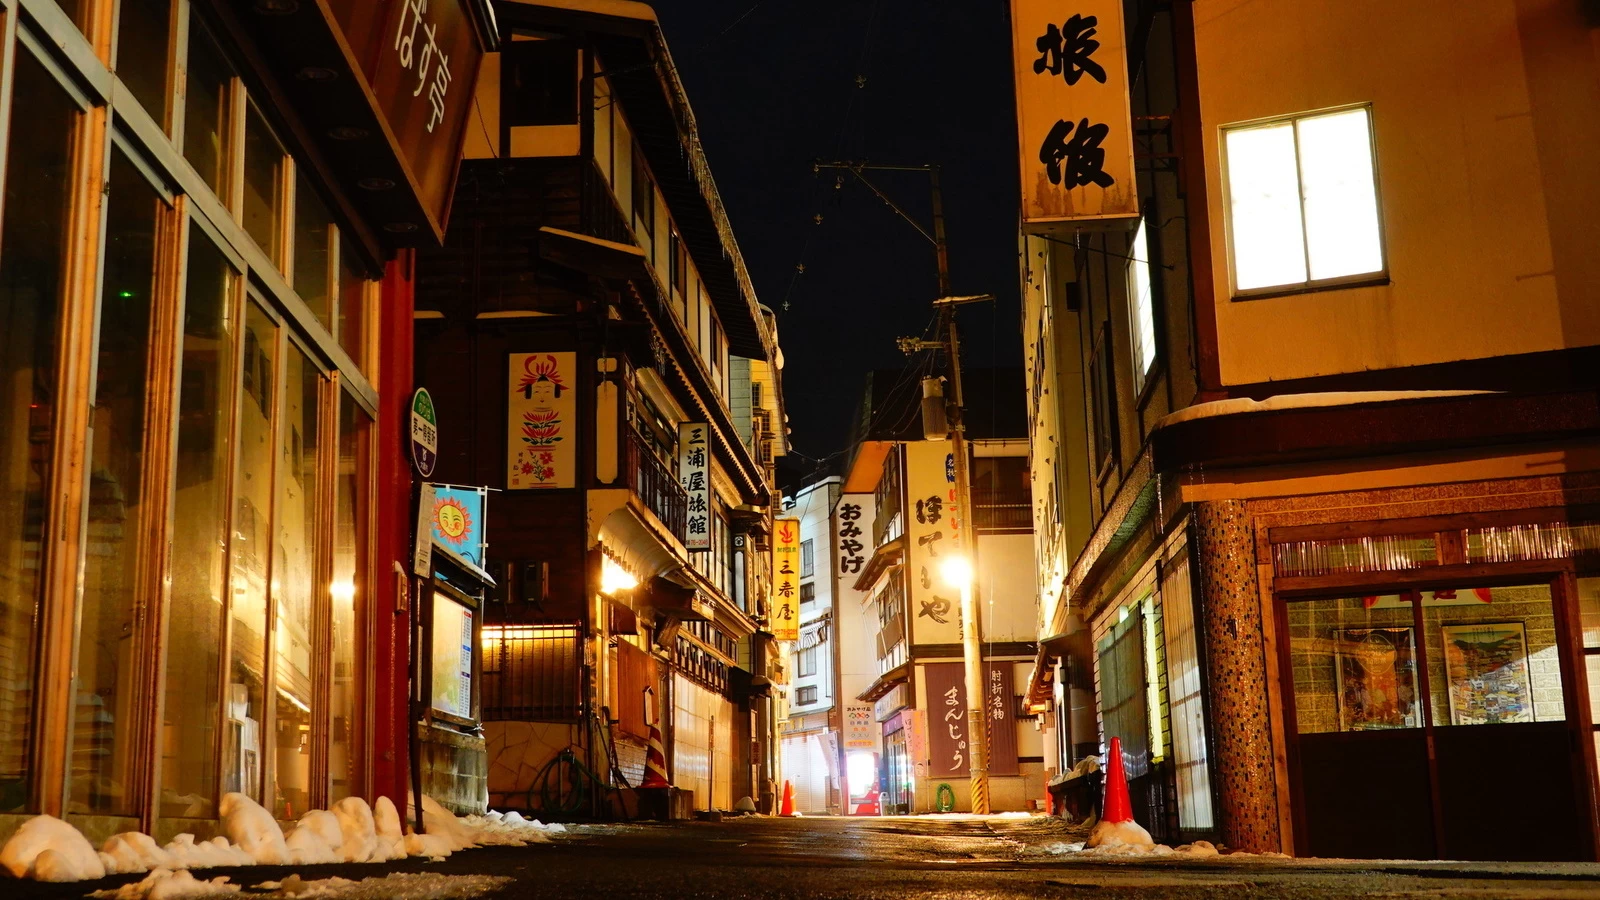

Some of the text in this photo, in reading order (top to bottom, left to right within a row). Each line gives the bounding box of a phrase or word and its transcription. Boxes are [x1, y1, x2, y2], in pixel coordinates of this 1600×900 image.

[687, 428, 707, 534] 三浦屋旅館
[839, 503, 864, 574] おみやげ
[776, 559, 795, 621] 三春屋
[944, 685, 966, 771] まんじゅう
[991, 670, 1005, 720] 肘折名物
